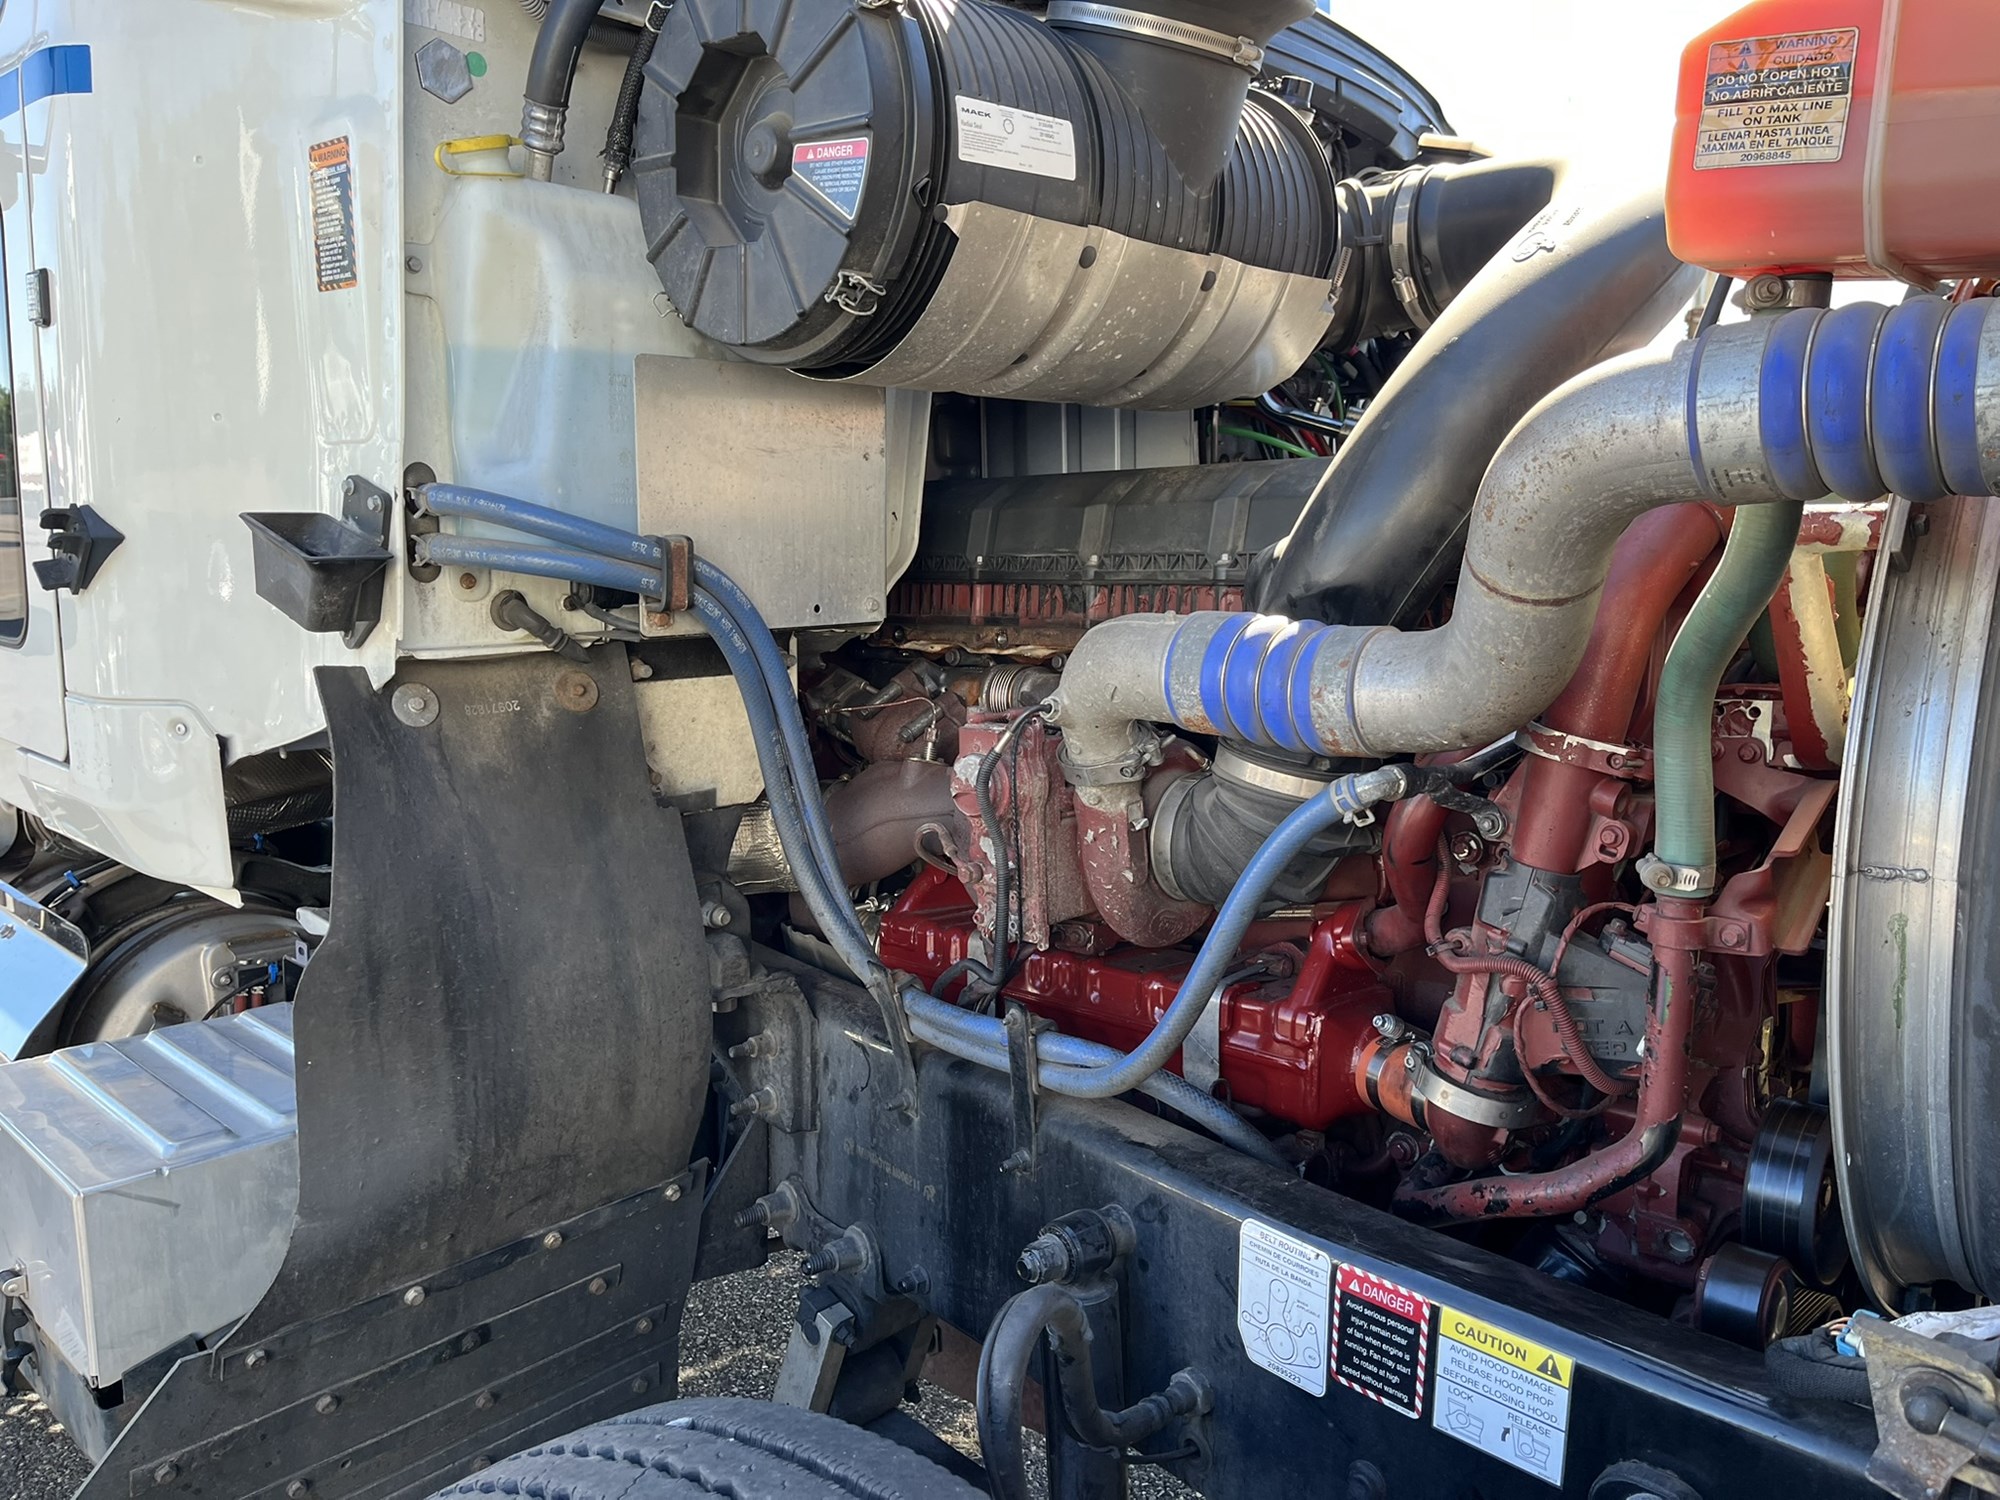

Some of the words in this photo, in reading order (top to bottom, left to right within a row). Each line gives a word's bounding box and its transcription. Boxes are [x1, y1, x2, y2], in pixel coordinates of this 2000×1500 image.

[1776, 35, 1837, 49] WARNING
[1773, 52, 1833, 65] CUIDADO
[1717, 76, 1735, 86] DO
[1739, 73, 1764, 83] NOT
[1770, 70, 1807, 80] OPEN
[1811, 66, 1839, 77] HOT
[1711, 91, 1729, 101] NO
[1733, 88, 1772, 99] ABRIR
[1777, 82, 1842, 96] CALIENTE
[961, 107, 991, 118] MACK
[1718, 107, 1743, 118] FILL
[1748, 106, 1765, 115] TO
[1769, 104, 1798, 114] MAX
[1802, 101, 1832, 111] LINE
[1743, 117, 1762, 126] ON
[1767, 114, 1801, 124] TANK
[1702, 141, 1745, 153] MAXIMA
[1751, 140, 1764, 148] EN
[1768, 139, 1781, 147] EL
[1786, 136, 1833, 146] TANQUE
[1708, 130, 1750, 142] LLENAR
[1755, 127, 1791, 138] HASTA
[1795, 125, 1829, 135] LINEA
[318, 146, 346, 162] WARNING
[817, 145, 853, 158] DANGER
[465, 700, 520, 716] 20971828
[1615, 1020, 1634, 1035] A
[1260, 1231, 1277, 1244] BELT
[1278, 1241, 1311, 1261] ROUTING
[1249, 1241, 1272, 1255] CHEMIN
[1273, 1252, 1281, 1260] DE
[1282, 1256, 1319, 1278] COURROIES
[1255, 1256, 1270, 1268] RUTA
[1271, 1264, 1280, 1273] DE
[1281, 1269, 1289, 1277] LA
[1290, 1273, 1312, 1288] BANDA
[1362, 1283, 1414, 1316] DANGER
[1346, 1300, 1363, 1312] Avoid
[1364, 1307, 1386, 1323] serious
[1387, 1317, 1414, 1335] personal
[1351, 1315, 1368, 1329] injury,
[1369, 1324, 1391, 1338] remain
[1392, 1332, 1408, 1346] clear
[1354, 1330, 1364, 1340] fan
[1364, 1335, 1381, 1348] when
[1382, 1341, 1402, 1358] engine
[1404, 1352, 1410, 1361] is
[1455, 1321, 1528, 1362] CAUTION
[1344, 1339, 1368, 1356] running.
[1369, 1350, 1381, 1361] Fan
[1382, 1357, 1396, 1369] may
[1396, 1364, 1411, 1375] start
[1353, 1356, 1359, 1365] to
[1360, 1361, 1377, 1374] rotate
[1378, 1368, 1385, 1376] at
[1386, 1371, 1400, 1384] high
[1450, 1344, 1478, 1362] AVOID
[1480, 1355, 1510, 1375] HOOD
[1342, 1364, 1360, 1378] speed
[1361, 1371, 1382, 1389] without
[1384, 1383, 1409, 1403] warning.
[1448, 1385, 1474, 1403] LOCK
[1450, 1357, 1493, 1382] RELEASE
[1495, 1376, 1524, 1396] HOOD
[1526, 1390, 1554, 1408] PROP
[1443, 1367, 1480, 1388] BEFORE
[1482, 1384, 1526, 1410] CLOSING
[1528, 1404, 1560, 1425] HOOD.
[1507, 1412, 1551, 1438] RELEASE
